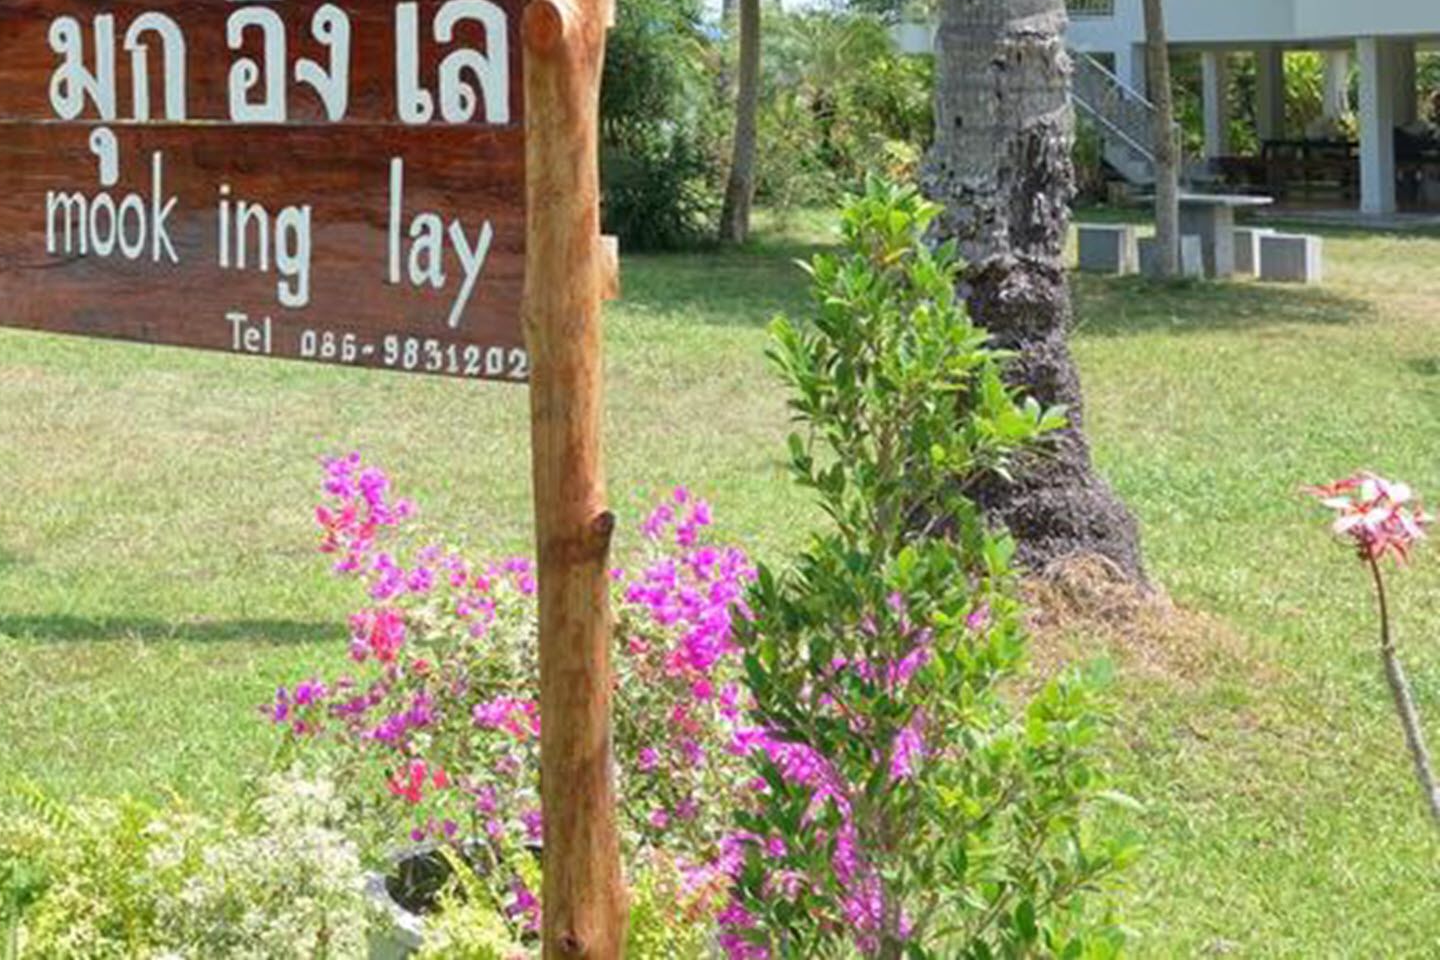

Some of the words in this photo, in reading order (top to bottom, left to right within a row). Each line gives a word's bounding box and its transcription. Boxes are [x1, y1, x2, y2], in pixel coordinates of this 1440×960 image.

[48, 13, 187, 187] มุก
[46, 150, 179, 264] mook
[218, 183, 312, 308] ing
[388, 157, 494, 329] lay
[225, 312, 272, 354] Tel
